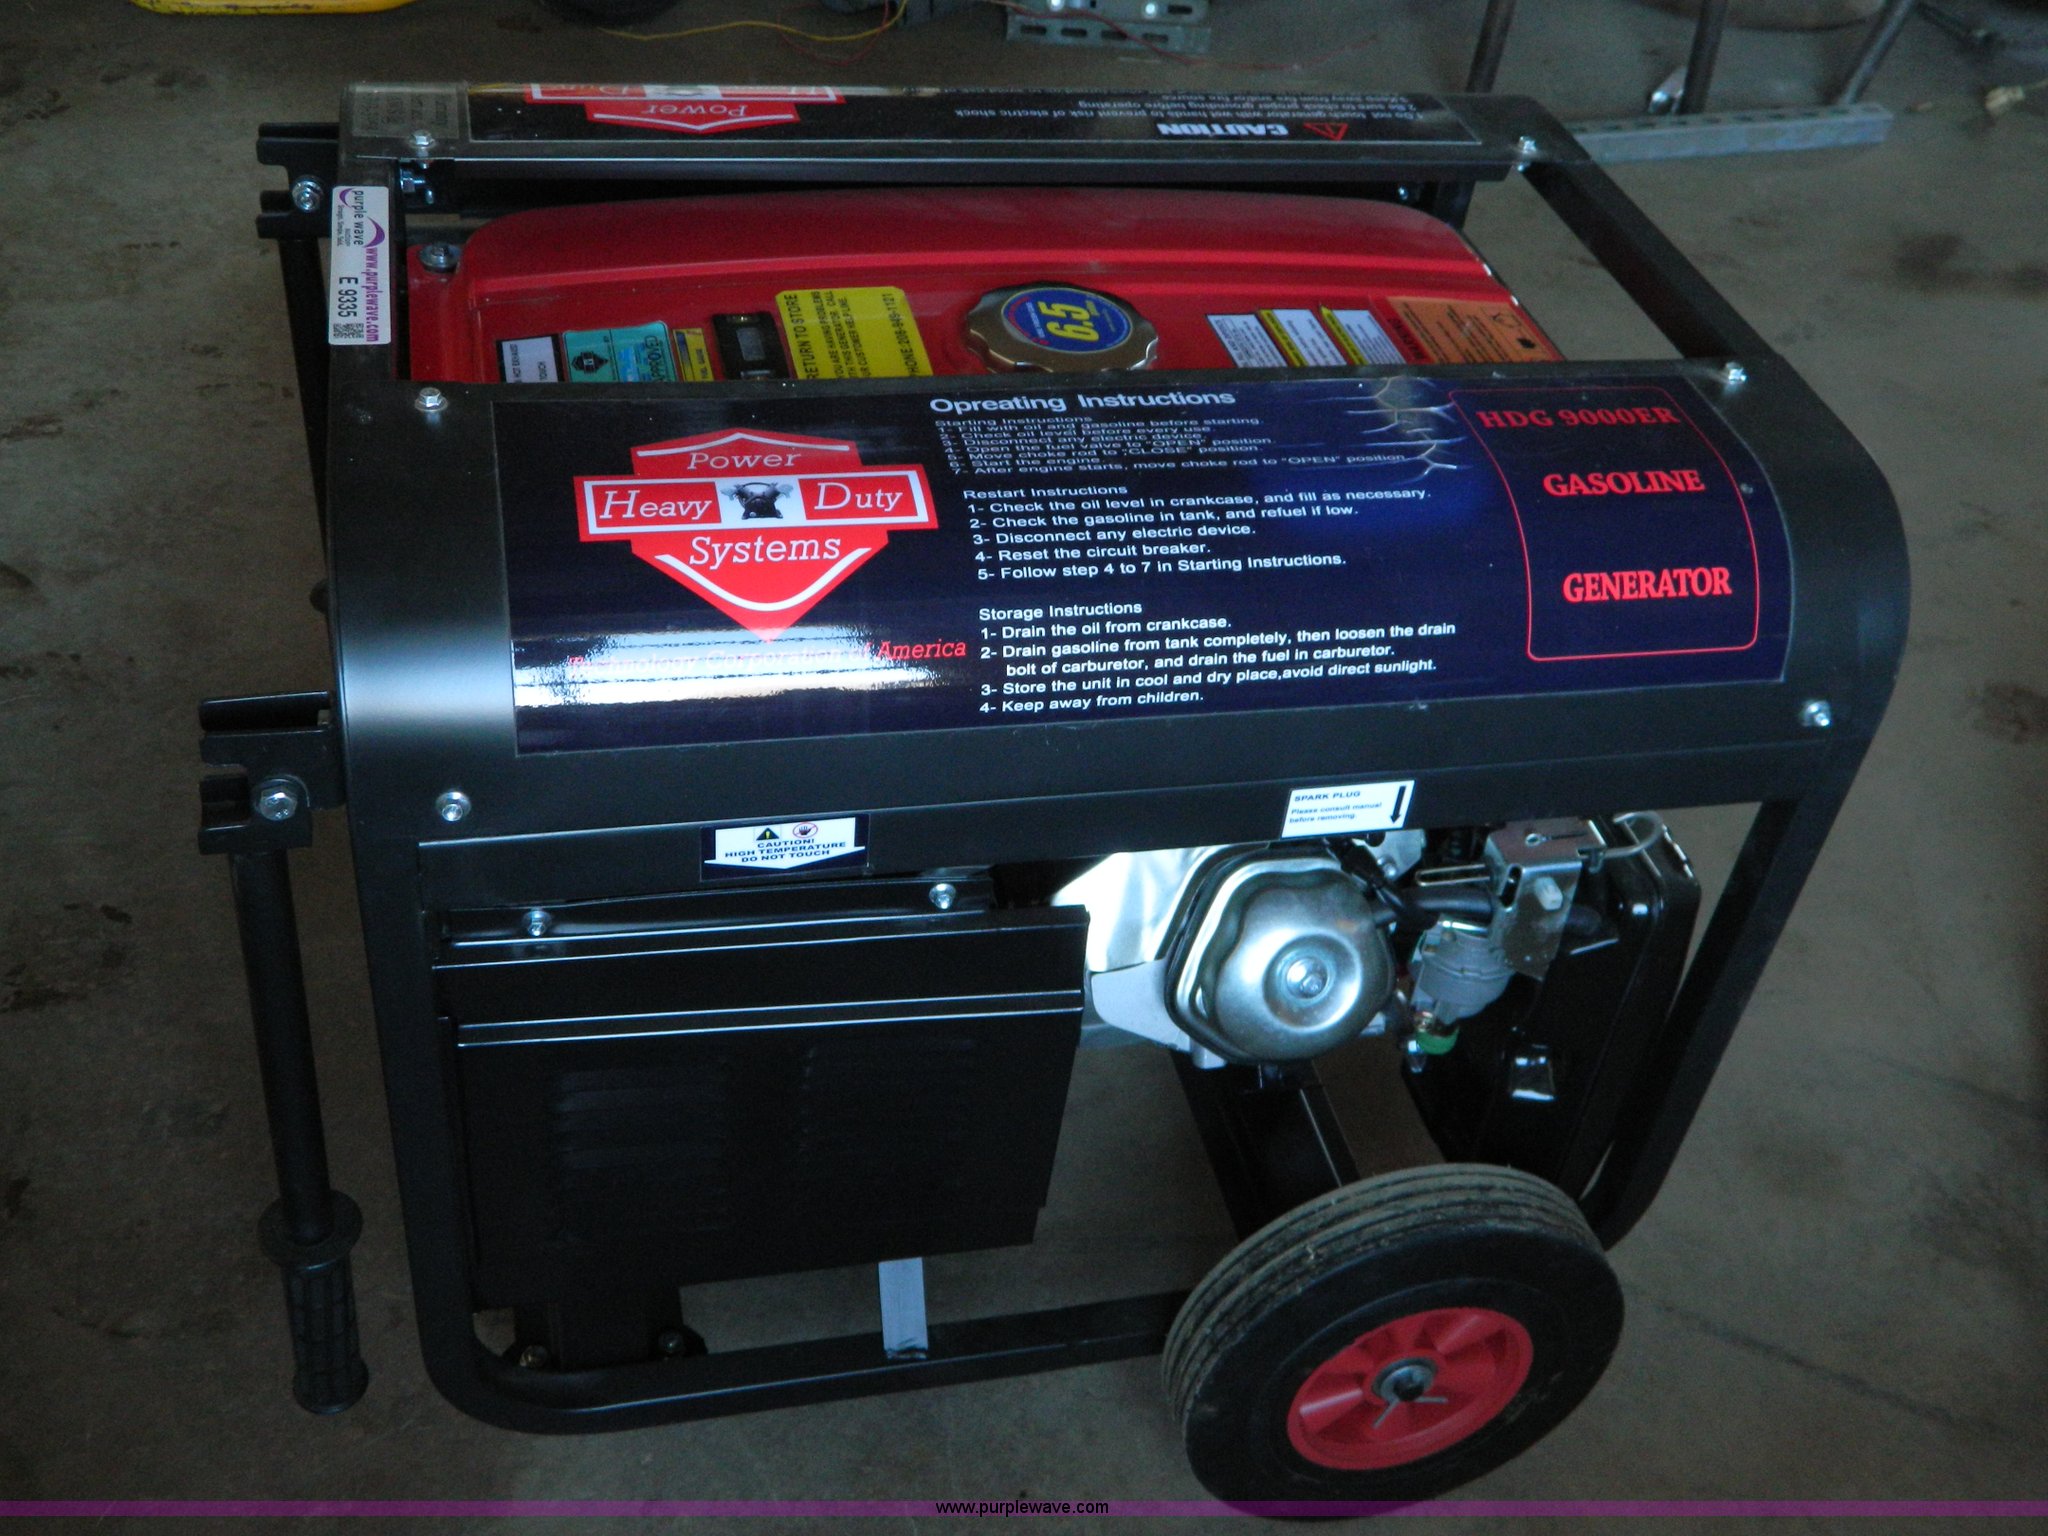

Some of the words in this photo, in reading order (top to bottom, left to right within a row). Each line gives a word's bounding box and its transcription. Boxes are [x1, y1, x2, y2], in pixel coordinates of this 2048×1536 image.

[641, 104, 748, 117] Power
[1156, 123, 1289, 137] CAUTION
[352, 190, 367, 218] purple
[353, 221, 364, 246] wave
[339, 276, 358, 285] E
[338, 290, 358, 318] 9335
[361, 247, 383, 342] www.purplewave.com
[783, 294, 803, 323] STORE
[792, 325, 808, 337] TO
[1037, 301, 1099, 342] 6.5
[797, 340, 819, 378] RETURN
[929, 395, 1067, 415] Opreating
[1077, 391, 1235, 407] Instructions
[1476, 409, 1553, 428] HDG
[1557, 407, 1678, 425] 9000ER
[687, 451, 802, 470] Power
[1019, 464, 1073, 474] engine
[1133, 461, 1177, 469] move
[1180, 459, 1228, 468] choke
[963, 488, 1025, 499] Restart
[1030, 485, 1127, 497] Instructions
[1542, 470, 1705, 496] GASOLINE
[599, 489, 712, 521] Heavy
[814, 482, 904, 512] Duty
[967, 503, 983, 513] 1-
[989, 501, 1044, 513] Check
[1048, 500, 1075, 511] the
[1080, 499, 1100, 509] oil
[1105, 497, 1144, 508] level
[1149, 497, 1164, 507] in
[1169, 495, 1259, 506] crankcase,
[1263, 492, 1294, 503] and
[1298, 491, 1317, 501] fill
[1321, 492, 1341, 501] as
[1345, 489, 1430, 499] necessary.
[969, 518, 986, 528] 2-
[992, 515, 1047, 528] Check
[1051, 515, 1078, 525] the
[1083, 512, 1154, 527] gasoline
[1159, 511, 1174, 521] in
[1178, 509, 1220, 521] tank,
[1225, 508, 1256, 519] and
[1260, 506, 1306, 517] refuel
[1311, 505, 1320, 515] if
[1325, 505, 1358, 515] low.
[972, 533, 990, 545] 3-
[995, 529, 1091, 544] Disconnect
[1096, 530, 1126, 541] any
[1131, 526, 1192, 539] electric
[1197, 525, 1255, 536] device.
[689, 535, 842, 569] Systems
[974, 550, 992, 562] 4-
[998, 548, 1049, 561] Reset
[1053, 547, 1080, 559] the
[1086, 544, 1137, 557] circuit
[1141, 543, 1210, 555] breaker.
[977, 568, 995, 580] 5-
[1000, 566, 1056, 579] Follow
[1062, 564, 1098, 578] step
[1103, 562, 1114, 574] 4
[1119, 562, 1136, 574] to
[1140, 561, 1151, 573] 7
[1156, 560, 1172, 572] in
[1177, 558, 1242, 571] Starting
[1247, 554, 1346, 568] Instructions.
[1562, 567, 1731, 602] GENERATOR
[979, 607, 1043, 621] Storage
[1049, 602, 1142, 617] Instructions
[980, 627, 996, 639] 1-
[1001, 624, 1045, 639] Drain
[1050, 623, 1077, 636] the
[1081, 621, 1100, 635] oil
[1104, 620, 1141, 633] from
[1145, 617, 1231, 631] crankcase.
[876, 639, 968, 660] America
[980, 646, 997, 659] 2-
[1002, 643, 1046, 658] Drain
[1051, 640, 1119, 658] gasoline
[1123, 638, 1160, 651] from
[1164, 635, 1199, 649] tank
[1203, 631, 1291, 648] completely,
[1296, 629, 1330, 642] then
[1334, 627, 1385, 640] loosen
[1389, 624, 1414, 637] the
[1417, 622, 1455, 636] drain
[1006, 662, 1036, 676] bolt
[1040, 661, 1058, 674] of
[1061, 657, 1148, 673] carburetor,
[1153, 654, 1183, 668] and
[1188, 652, 1227, 666] drain
[1232, 651, 1257, 664] the
[1261, 648, 1290, 662] fuel
[1294, 648, 1308, 660] in
[1312, 644, 1394, 659] carburetor.
[980, 683, 997, 696] 3-
[1002, 682, 1046, 694] Store
[1050, 679, 1076, 692] the
[1081, 676, 1111, 690] unit
[1116, 676, 1130, 688] in
[1134, 673, 1168, 687] cool
[1172, 671, 1202, 685] and
[1206, 670, 1232, 684] dry
[1235, 664, 1323, 684] place,avoid
[1327, 662, 1370, 676] direct
[1374, 658, 1436, 673] sunlight.
[979, 701, 996, 713] 4-
[1001, 700, 1044, 713] Keep
[1048, 698, 1091, 710] away
[1095, 694, 1132, 706] from
[1136, 690, 1203, 704] children.
[1294, 794, 1329, 802] SPARK
[1332, 790, 1361, 799] PLUG
[1291, 807, 1318, 815] Please
[1320, 804, 1350, 813] consult
[1352, 801, 1382, 809] manual
[725, 850, 755, 858] HIGH
[758, 841, 846, 854] TEMPERATURE
[757, 839, 815, 848] CAUTION!
[789, 850, 830, 859] TOUCH
